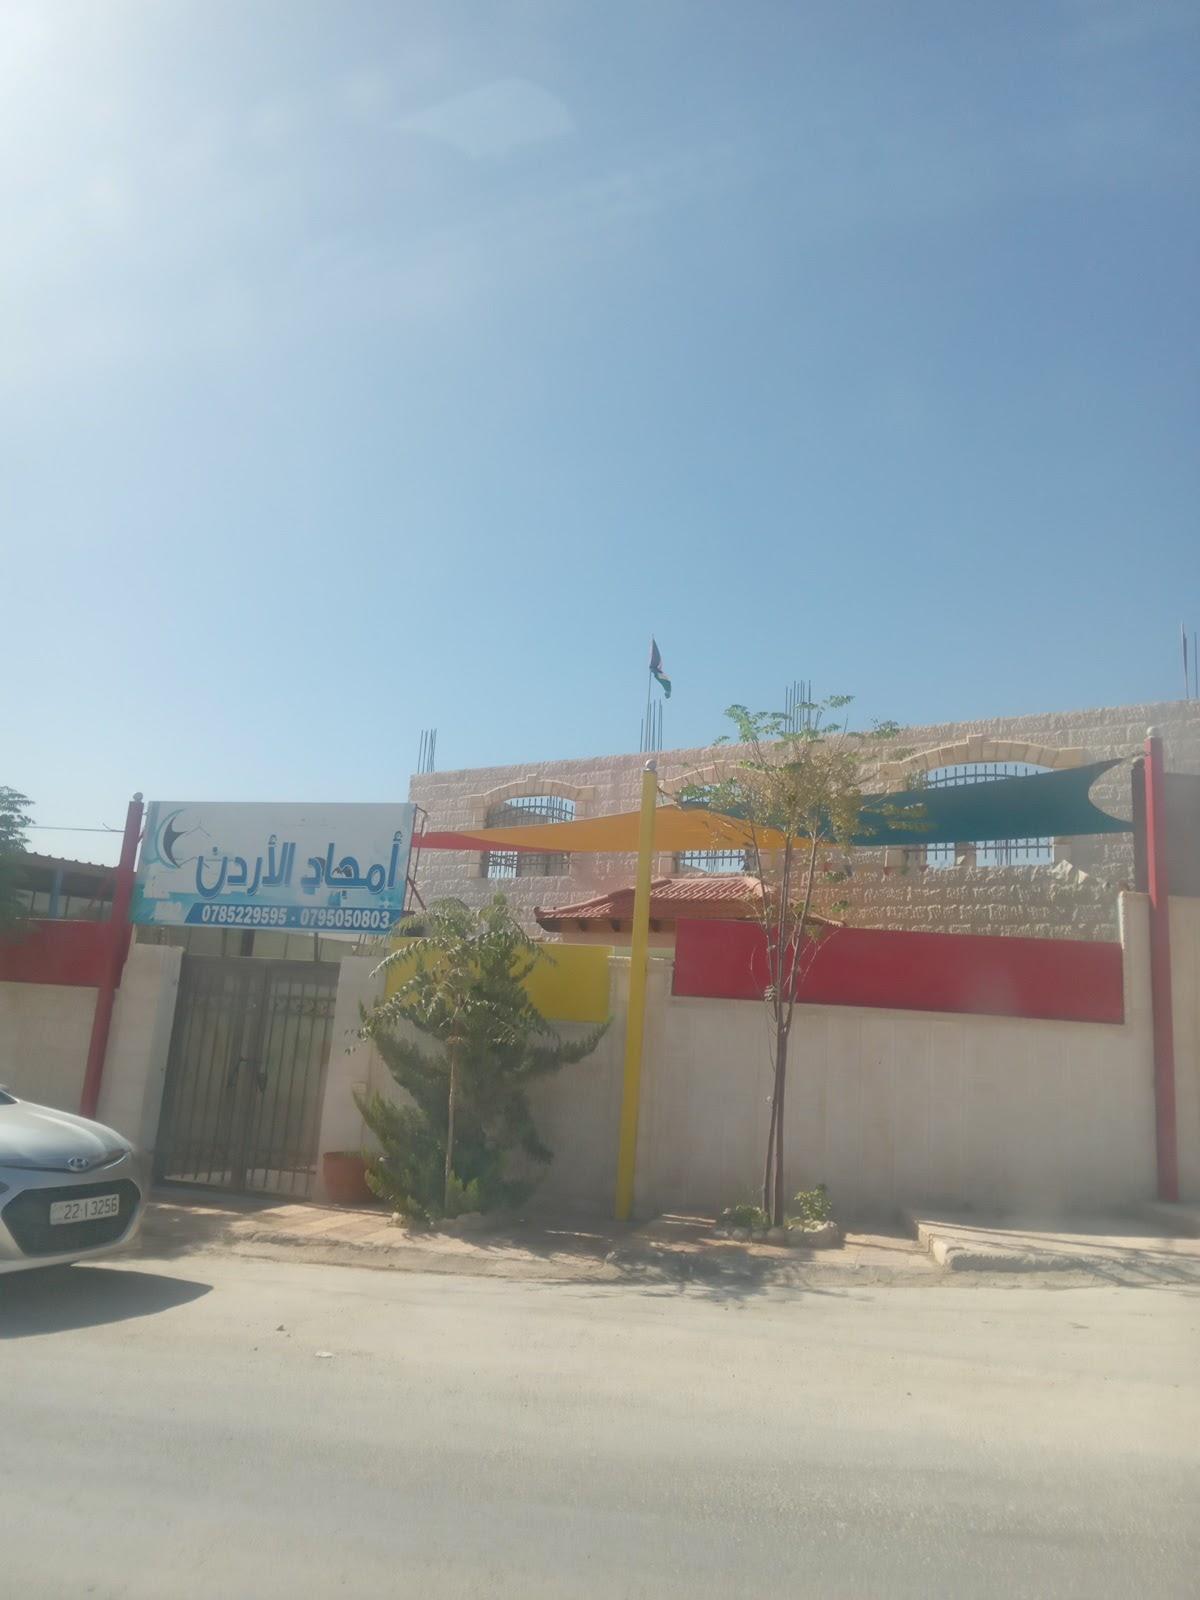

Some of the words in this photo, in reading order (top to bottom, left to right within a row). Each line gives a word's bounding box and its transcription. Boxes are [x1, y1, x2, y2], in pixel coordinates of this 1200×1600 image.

[196, 834, 296, 900] الأردن
[301, 830, 403, 899] أمجاد
[202, 905, 288, 925] 0785229595
[300, 908, 390, 929] 0795050803
